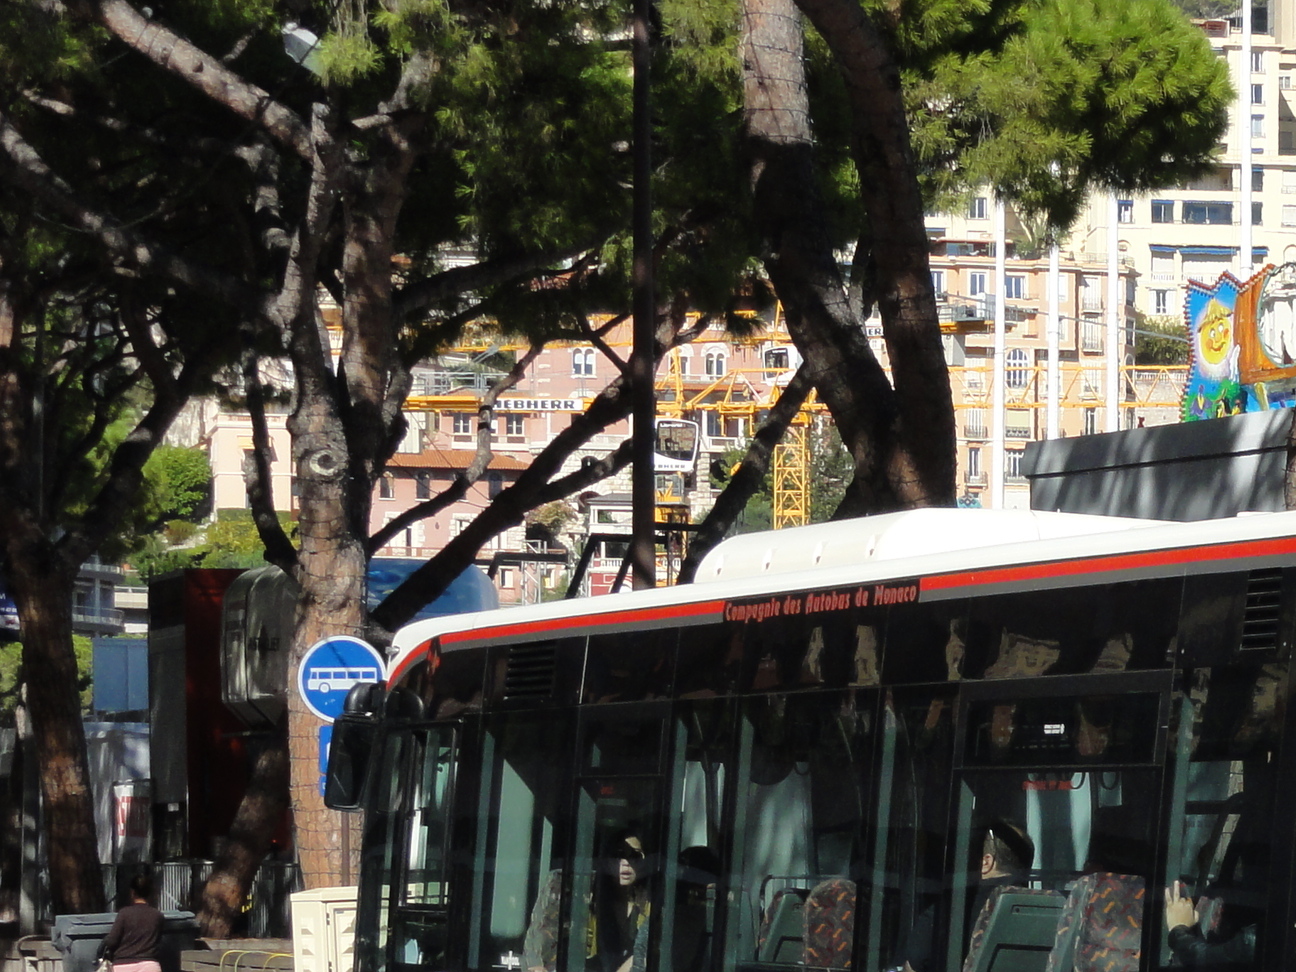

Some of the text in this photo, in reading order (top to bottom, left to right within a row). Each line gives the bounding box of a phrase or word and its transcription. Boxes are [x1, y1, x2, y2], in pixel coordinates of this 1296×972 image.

[725, 584, 917, 624] Compagnie des Autobus de Monaco
